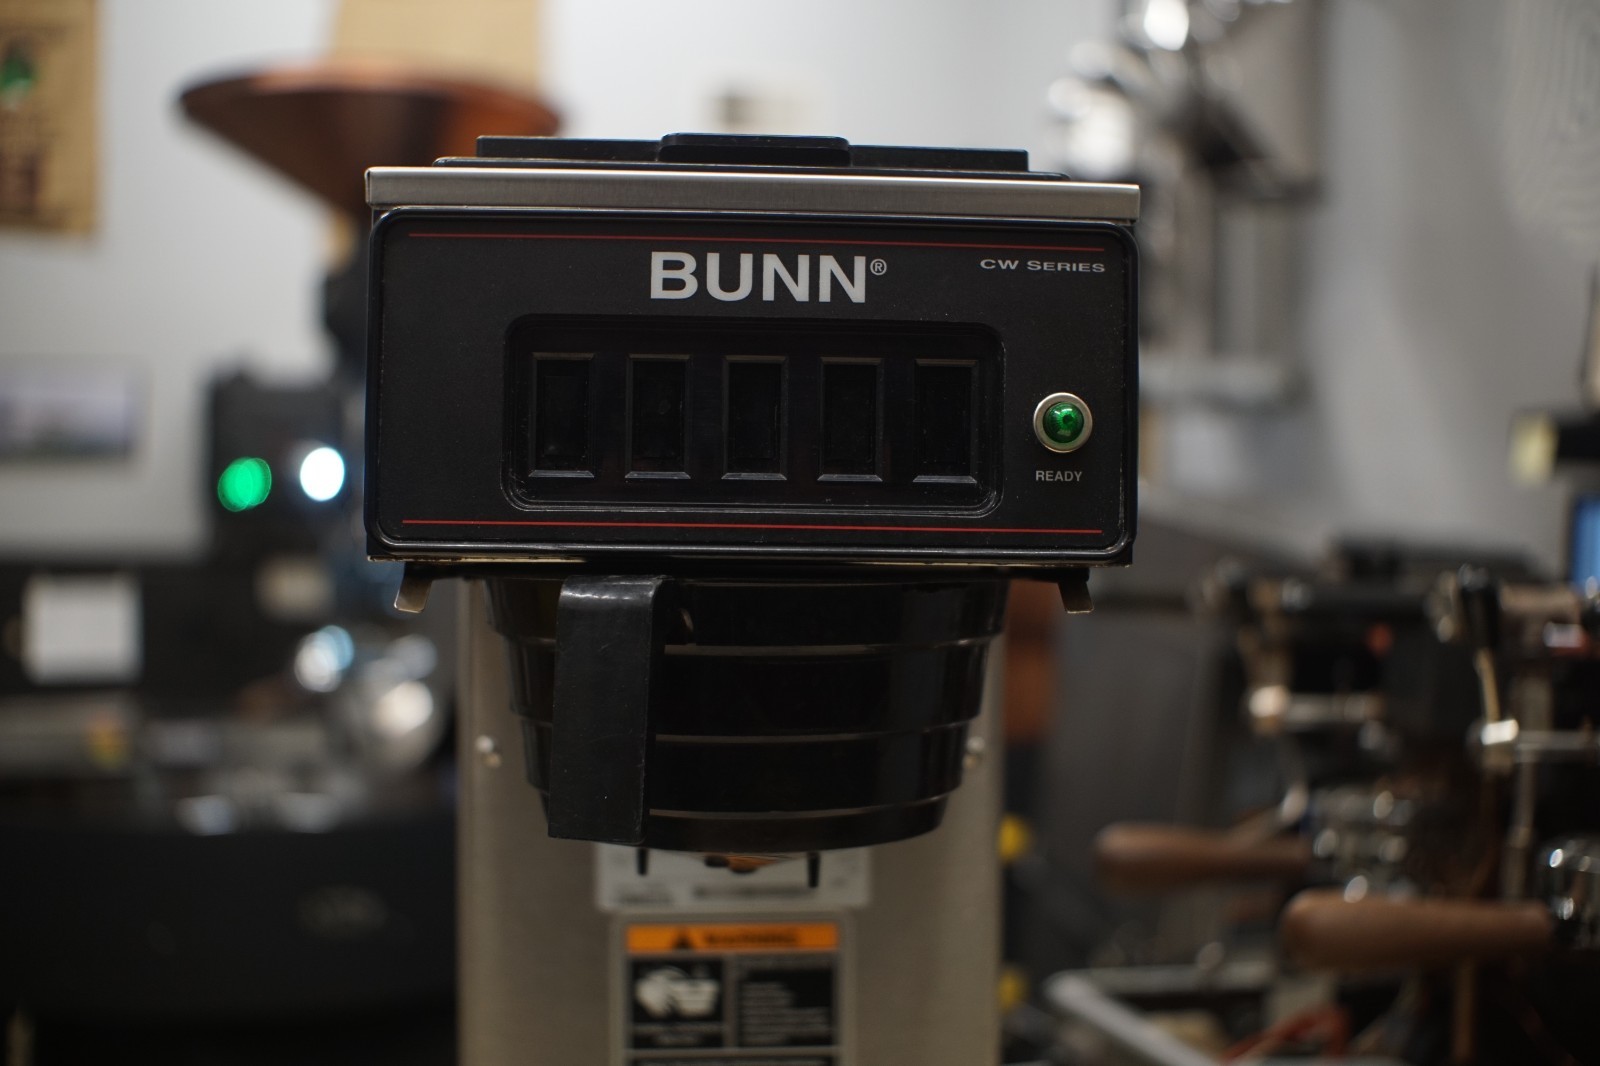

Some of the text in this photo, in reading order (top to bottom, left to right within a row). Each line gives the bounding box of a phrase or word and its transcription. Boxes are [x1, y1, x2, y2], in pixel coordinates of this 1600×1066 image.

[980, 259, 1106, 273] CW SERIES
[1035, 470, 1083, 482] READY
